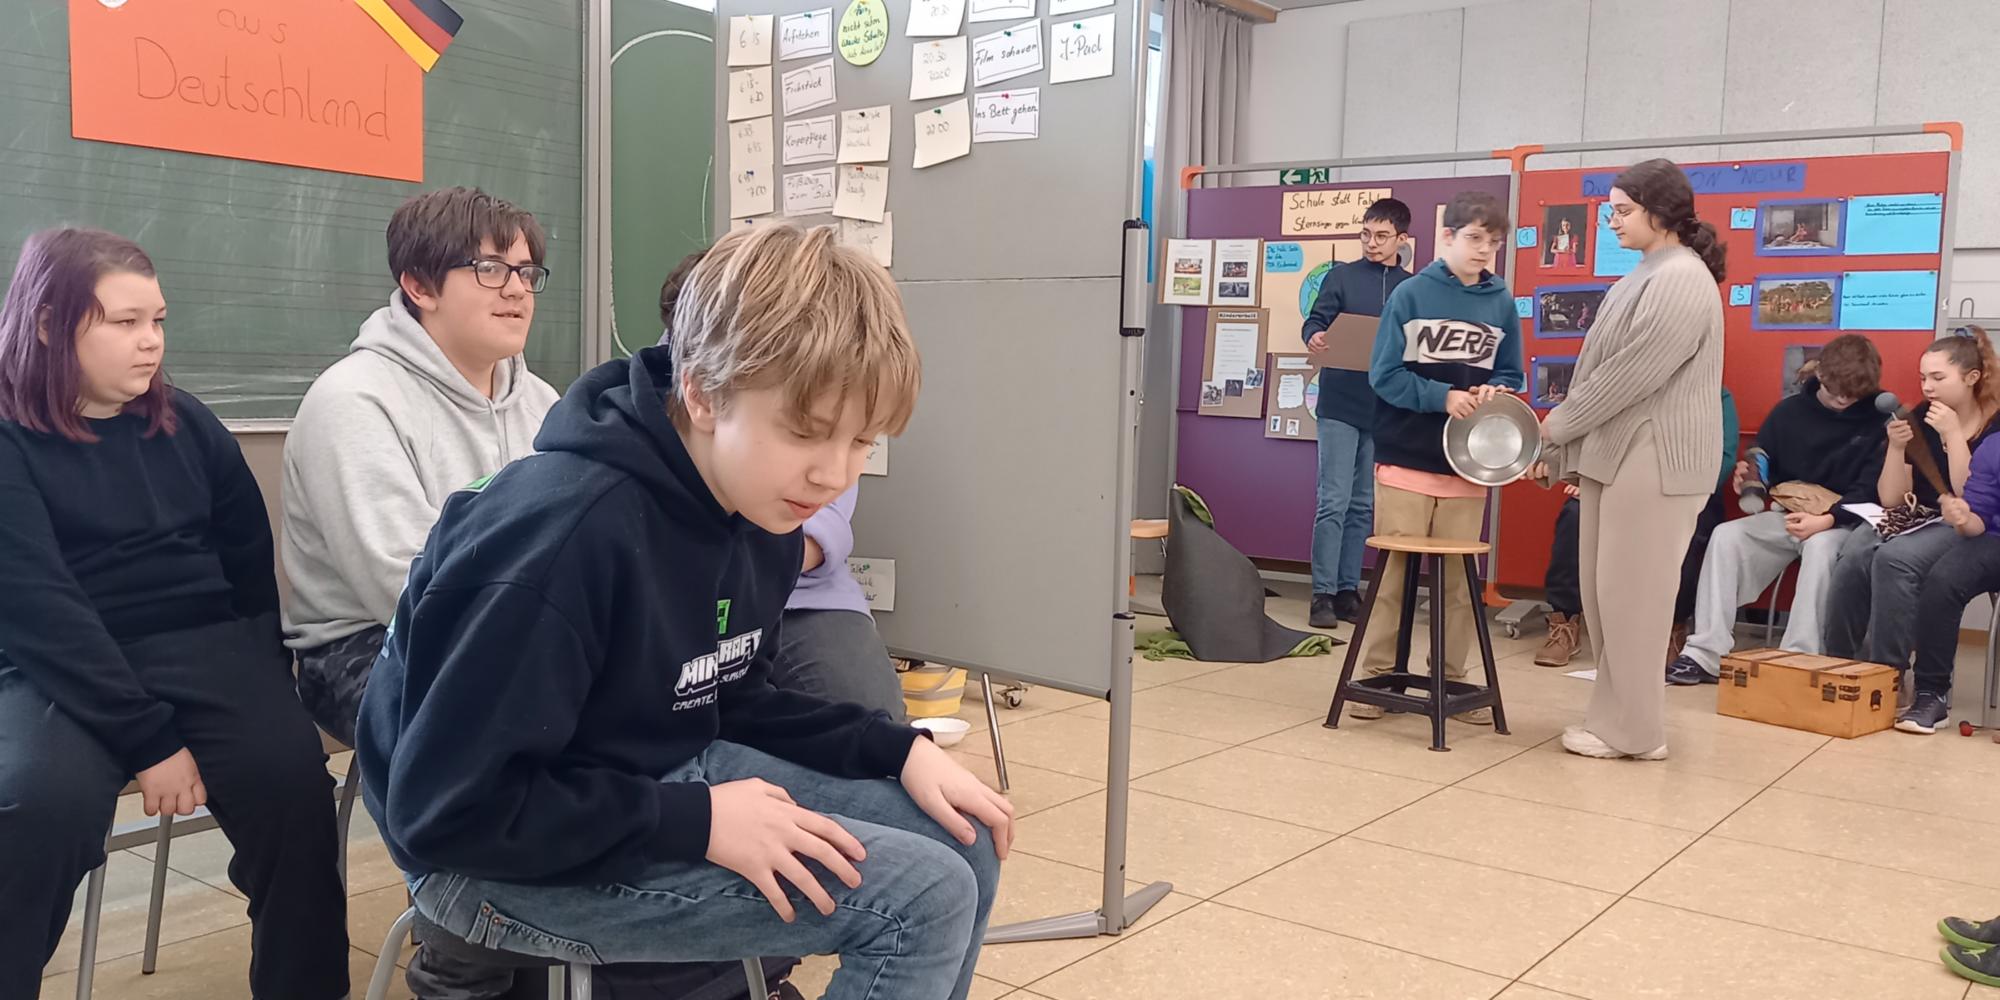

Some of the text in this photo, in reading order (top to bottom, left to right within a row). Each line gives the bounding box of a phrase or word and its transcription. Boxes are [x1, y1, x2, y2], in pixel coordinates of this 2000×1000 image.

[216, 8, 287, 44] aus
[975, 44, 1037, 65] Film schauen
[135, 36, 391, 142] Deutschland
[975, 103, 1039, 125] Ins Bett gehen
[1289, 192, 1325, 210] Schule
[1331, 191, 1351, 206] statt
[1737, 290, 1745, 301] 5
[1519, 301, 1528, 314] 2
[1417, 325, 1498, 355] NERF
